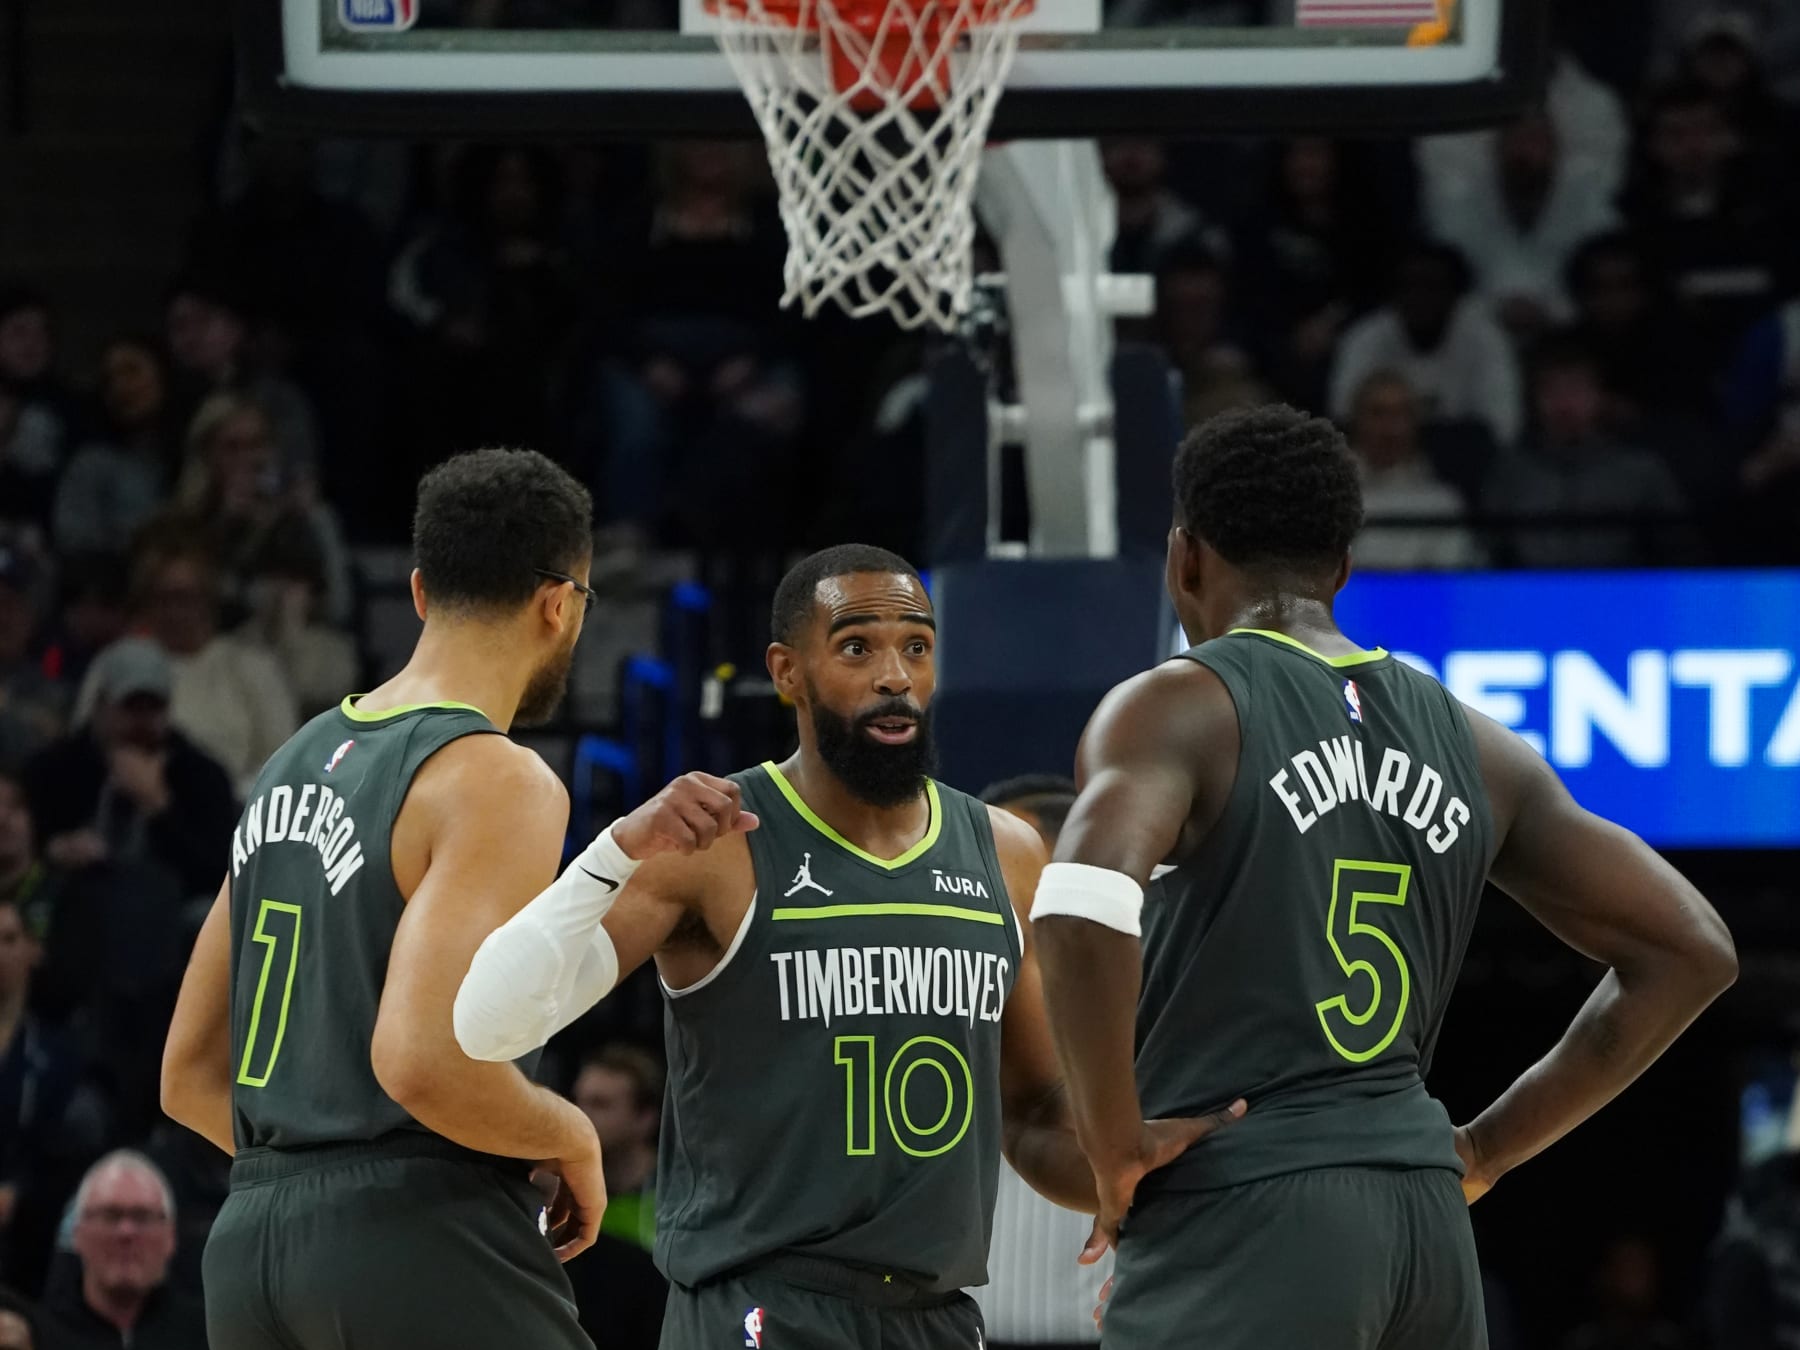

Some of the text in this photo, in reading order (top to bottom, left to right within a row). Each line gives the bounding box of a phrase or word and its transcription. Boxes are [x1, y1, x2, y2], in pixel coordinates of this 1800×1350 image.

[1391, 650, 1800, 768] ENT
[232, 783, 365, 897] ANDERSON
[236, 899, 302, 1088] 1
[770, 946, 1009, 1030] TIMBERWOLVES
[1315, 858, 1412, 1063] 5
[834, 1035, 974, 1158] 10
